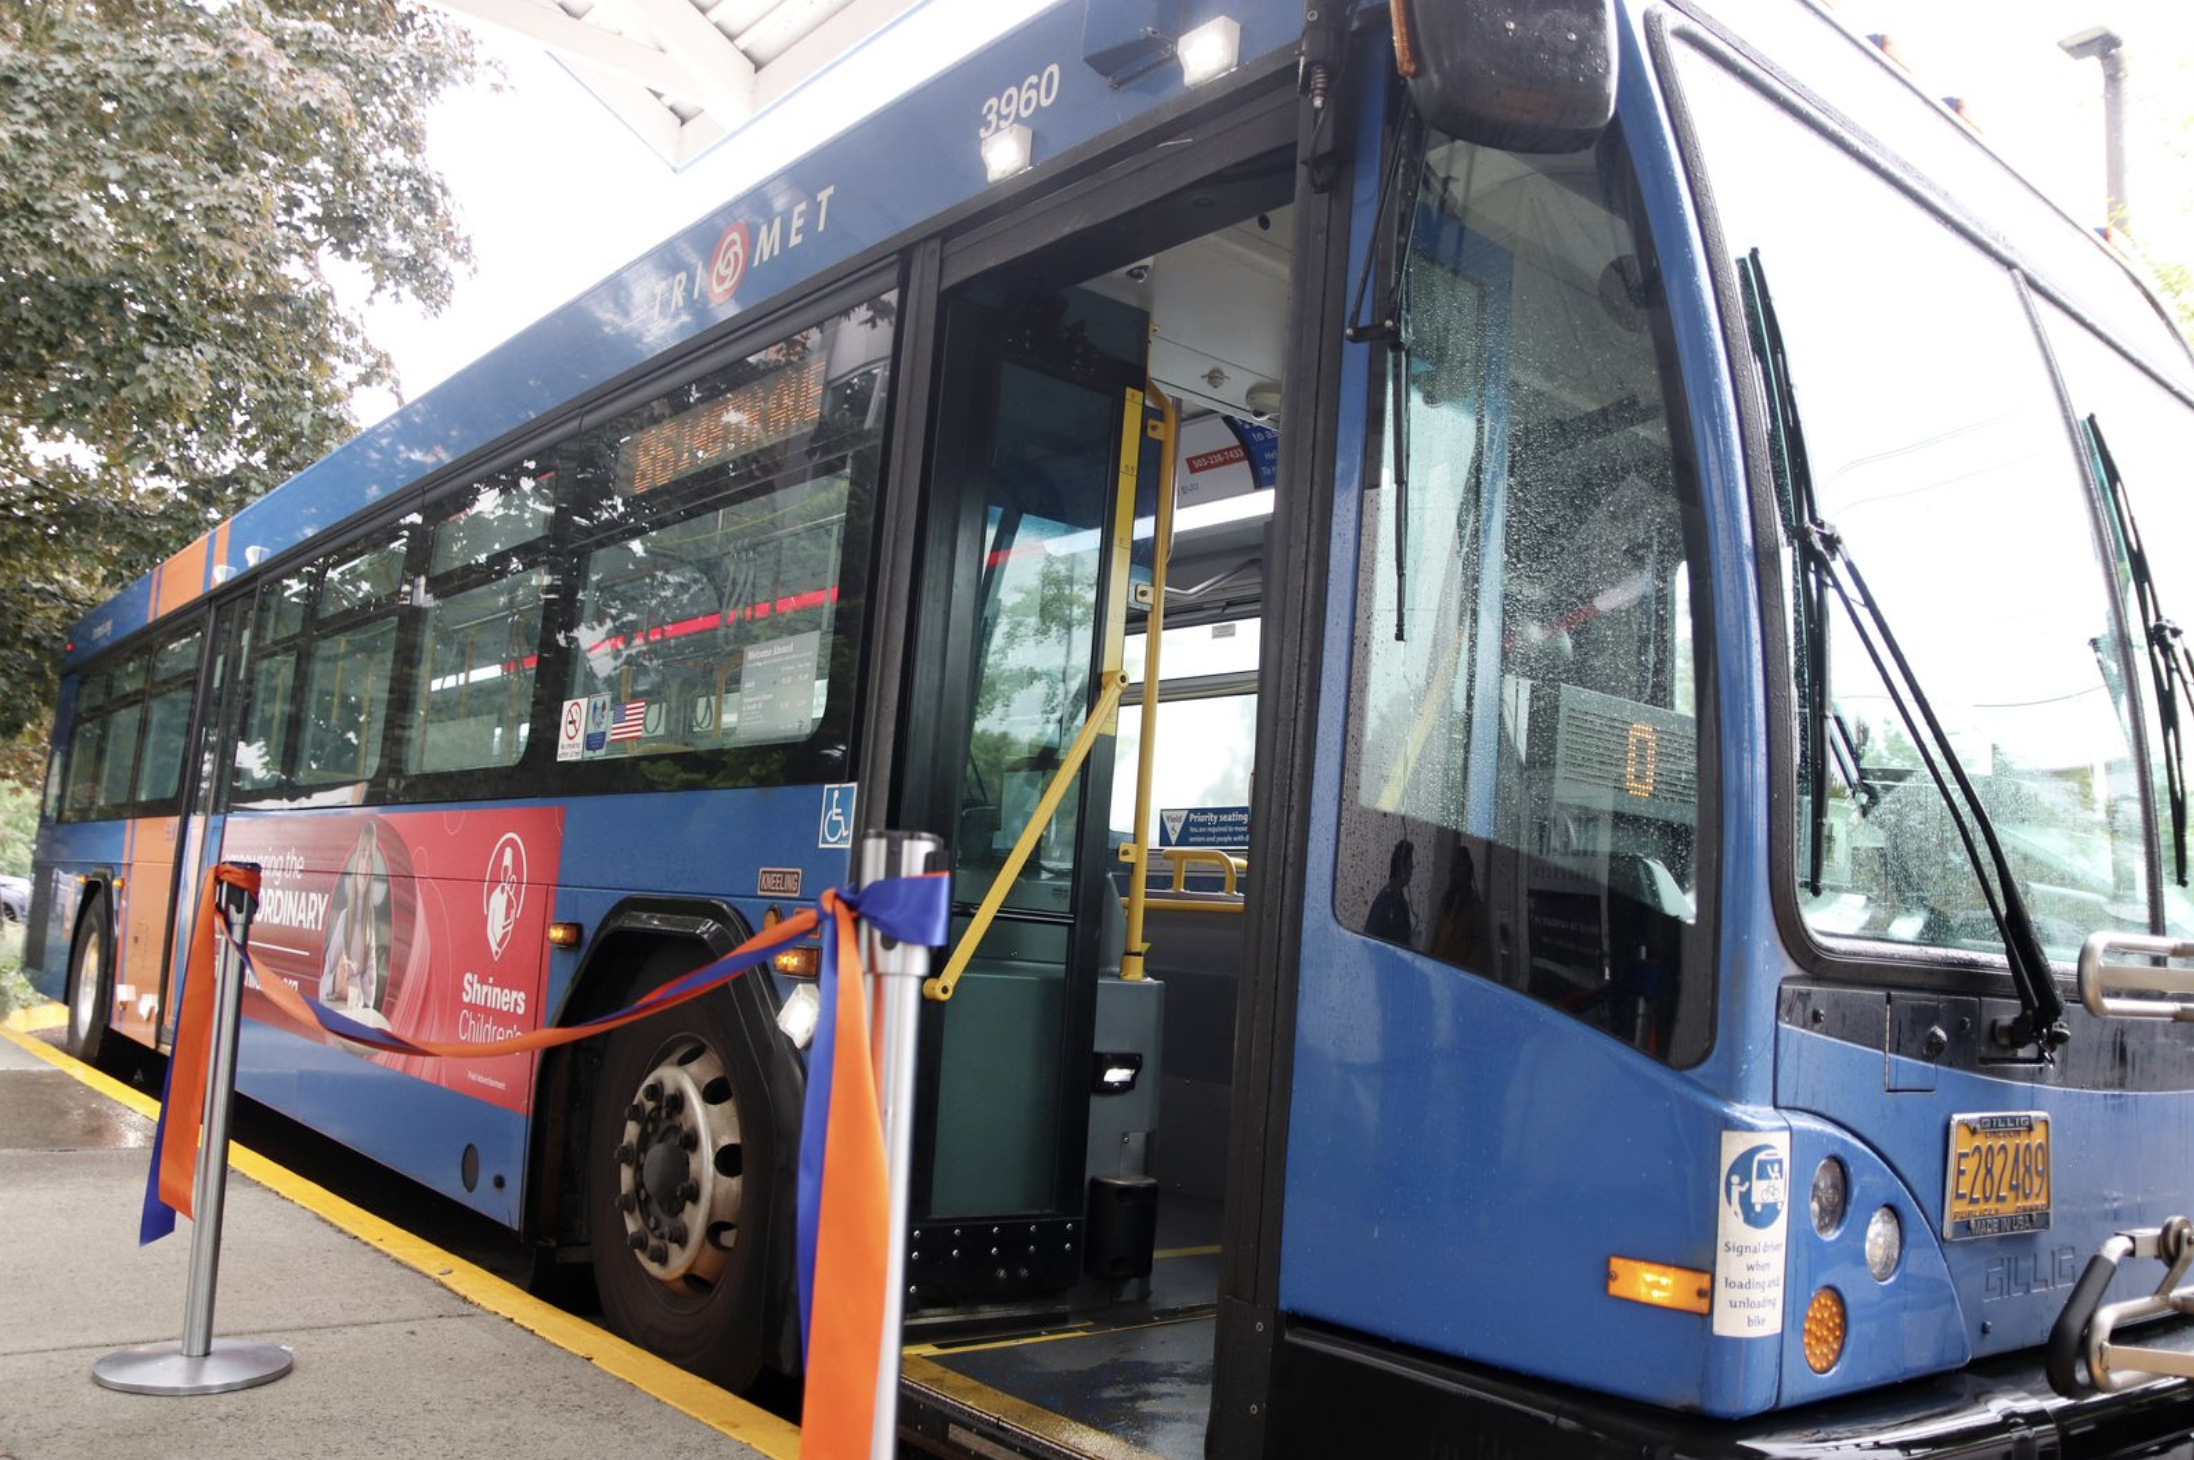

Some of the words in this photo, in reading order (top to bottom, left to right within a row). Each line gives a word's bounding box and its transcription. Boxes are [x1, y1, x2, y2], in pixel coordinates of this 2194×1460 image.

[979, 63, 1060, 139] 3960
[652, 260, 703, 323] TRI
[752, 184, 835, 268] MET
[1192, 448, 1245, 468] 503-238-7433
[1166, 813, 1183, 822] Yield
[1189, 812, 1218, 825] Priority
[1219, 811, 1249, 825] seating
[284, 846, 305, 879] the
[254, 887, 330, 932] ORDINARY
[462, 971, 526, 1015] Shriners
[1981, 1117, 2030, 1129] GILLIG
[1955, 1141, 2046, 1206] E282489
[1974, 1218, 1999, 1235] MADE
[2001, 1217, 2011, 1232] IN
[2012, 1214, 2032, 1230] USA
[1723, 1241, 1761, 1257] Signal
[1762, 1241, 1783, 1254] driver
[1746, 1260, 1770, 1272] when
[1982, 1245, 2076, 1302] GILLIG
[1724, 1277, 1765, 1293] loading
[1729, 1297, 1777, 1310] unloading
[1747, 1315, 1766, 1328] bike
